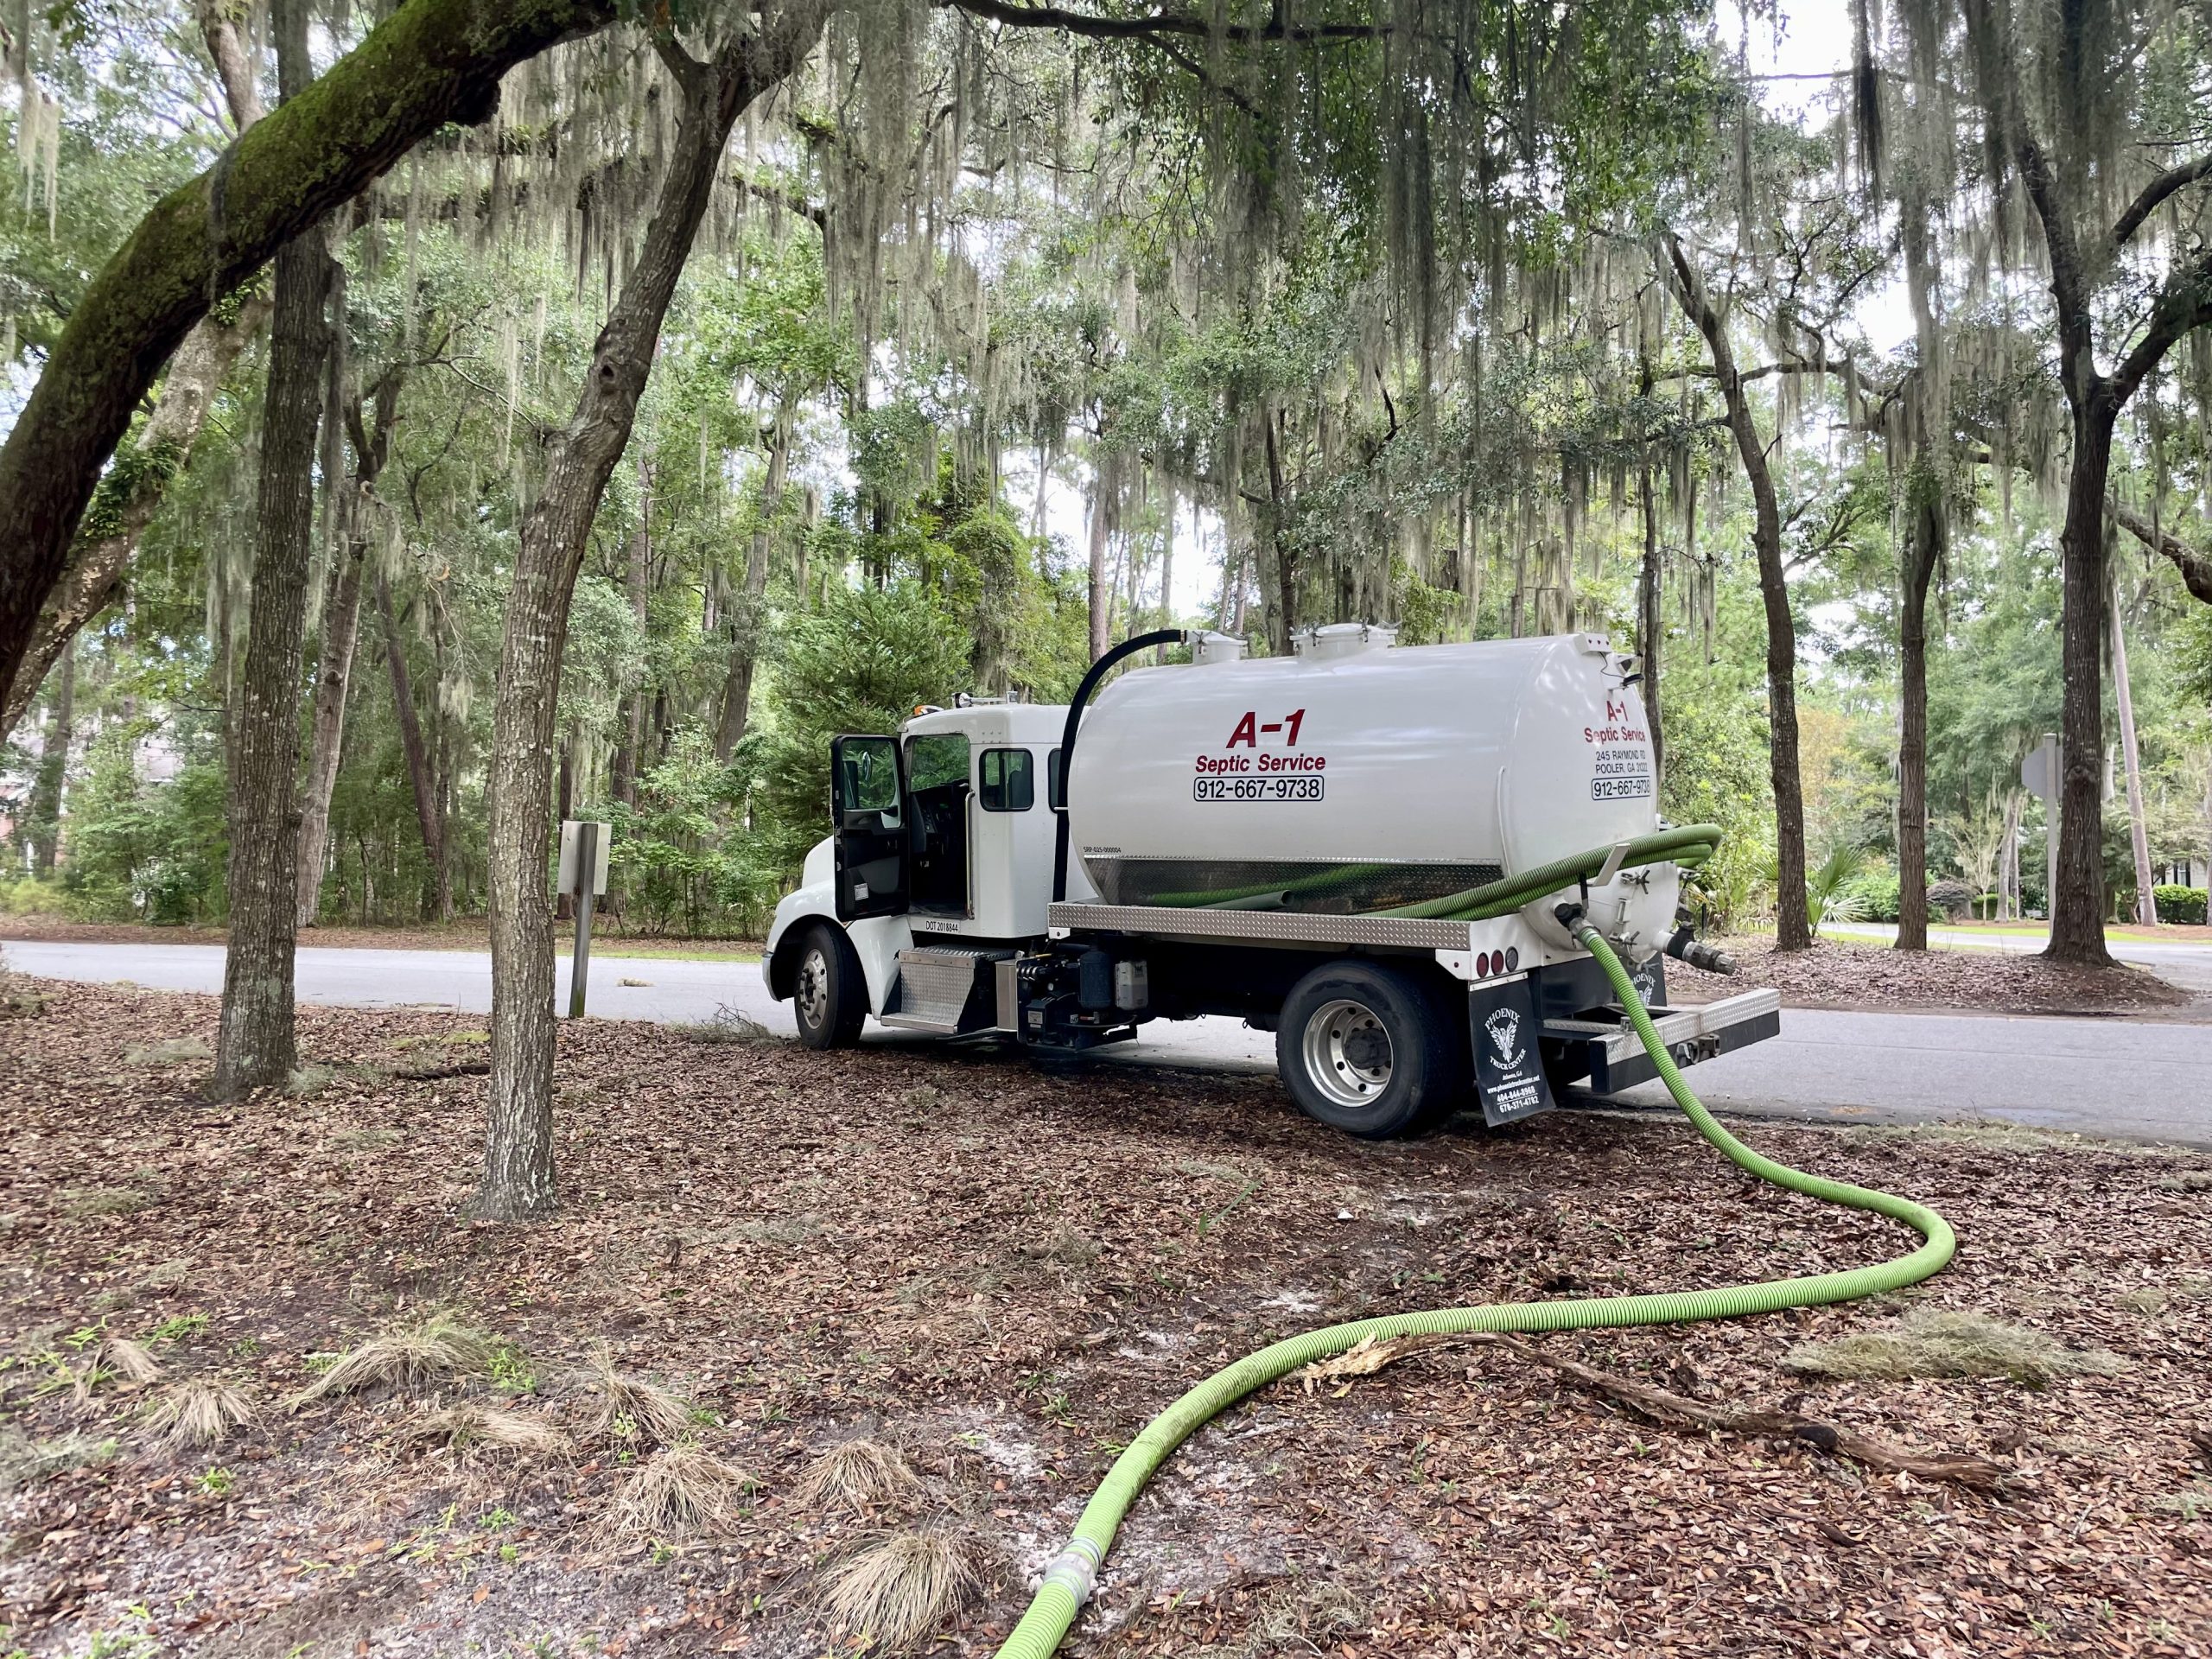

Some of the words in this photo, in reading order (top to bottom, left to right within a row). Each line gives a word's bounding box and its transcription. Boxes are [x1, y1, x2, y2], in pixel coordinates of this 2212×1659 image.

[1606, 700, 1628, 721] A-1
[1225, 709, 1306, 748] A-1
[1584, 727, 1619, 744] Septic
[1621, 726, 1646, 742] Service
[1195, 754, 1250, 775] Septic
[1257, 753, 1326, 772] Service
[1596, 751, 1611, 761] 245
[1612, 750, 1639, 760] RAYMOND
[1627, 762, 1636, 772] GA
[1197, 779, 1320, 798] 912-667-9738
[1593, 779, 1650, 797] 912-667-9738
[925, 920, 937, 931] DOT
[1631, 973, 1656, 987] HOENIX
[1484, 1007, 1521, 1031] PHOENIX
[1490, 1055, 1509, 1071] TRUCK
[1508, 1048, 1527, 1070] CENTER
